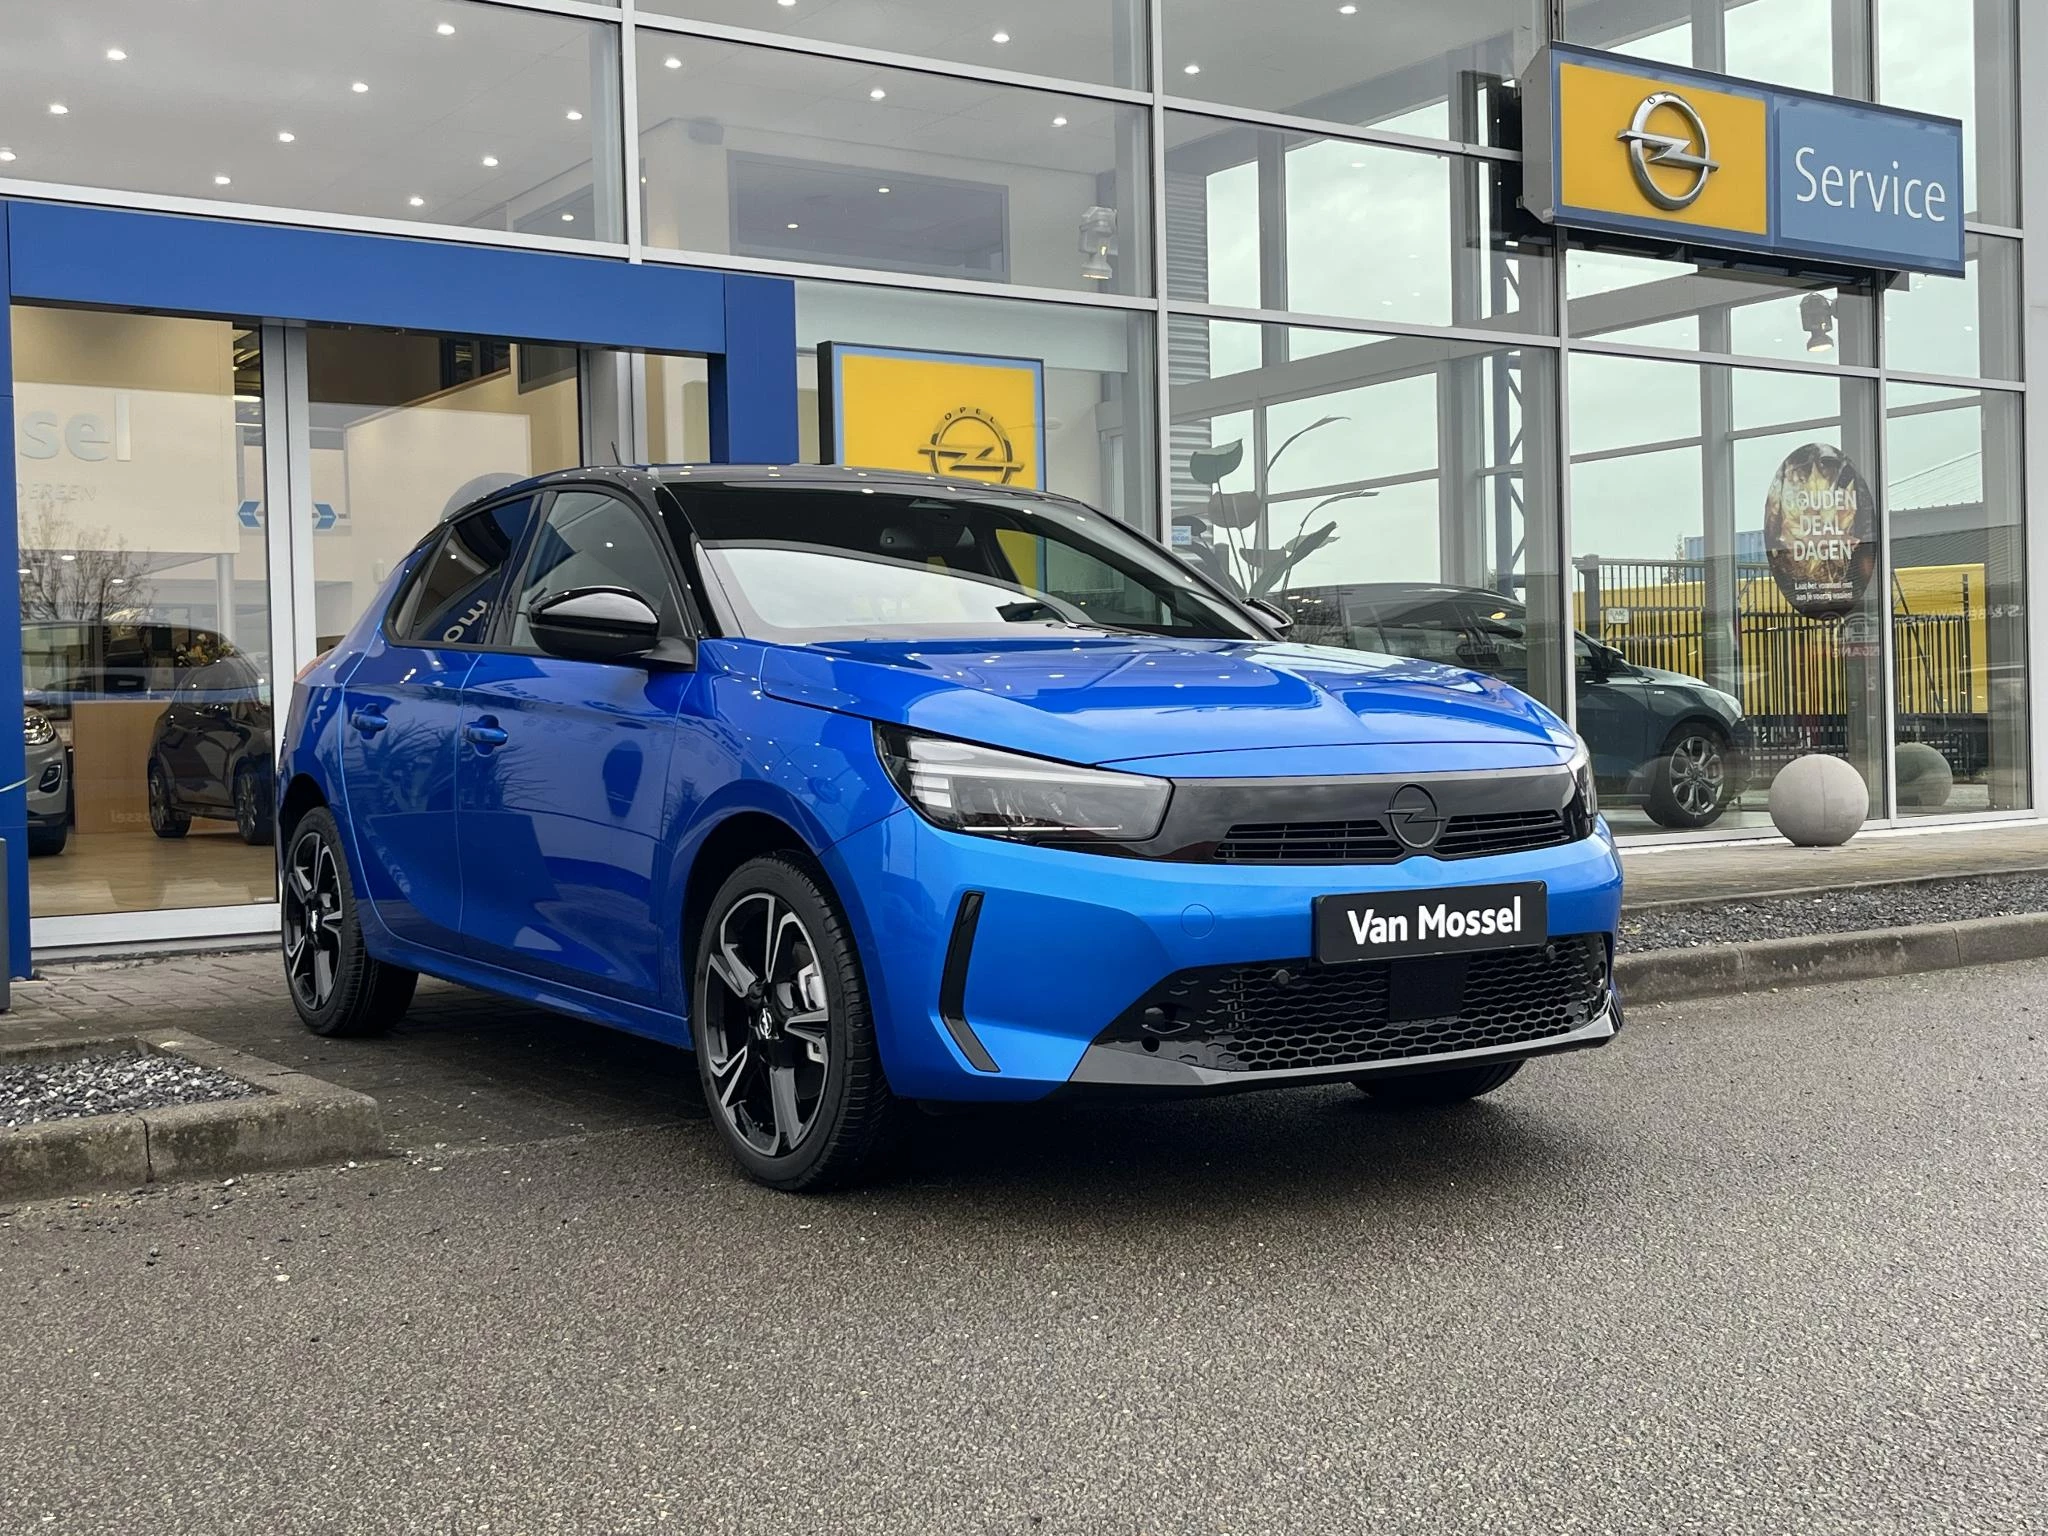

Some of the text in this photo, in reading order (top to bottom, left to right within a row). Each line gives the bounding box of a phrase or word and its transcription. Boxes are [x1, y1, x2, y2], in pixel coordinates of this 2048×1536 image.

[1795, 147, 1946, 222] Service
[944, 406, 996, 424] OPEL
[1800, 514, 1844, 536] DEAL
[1793, 539, 1852, 561] DAGEN
[1347, 895, 1521, 945] Van Mossel
